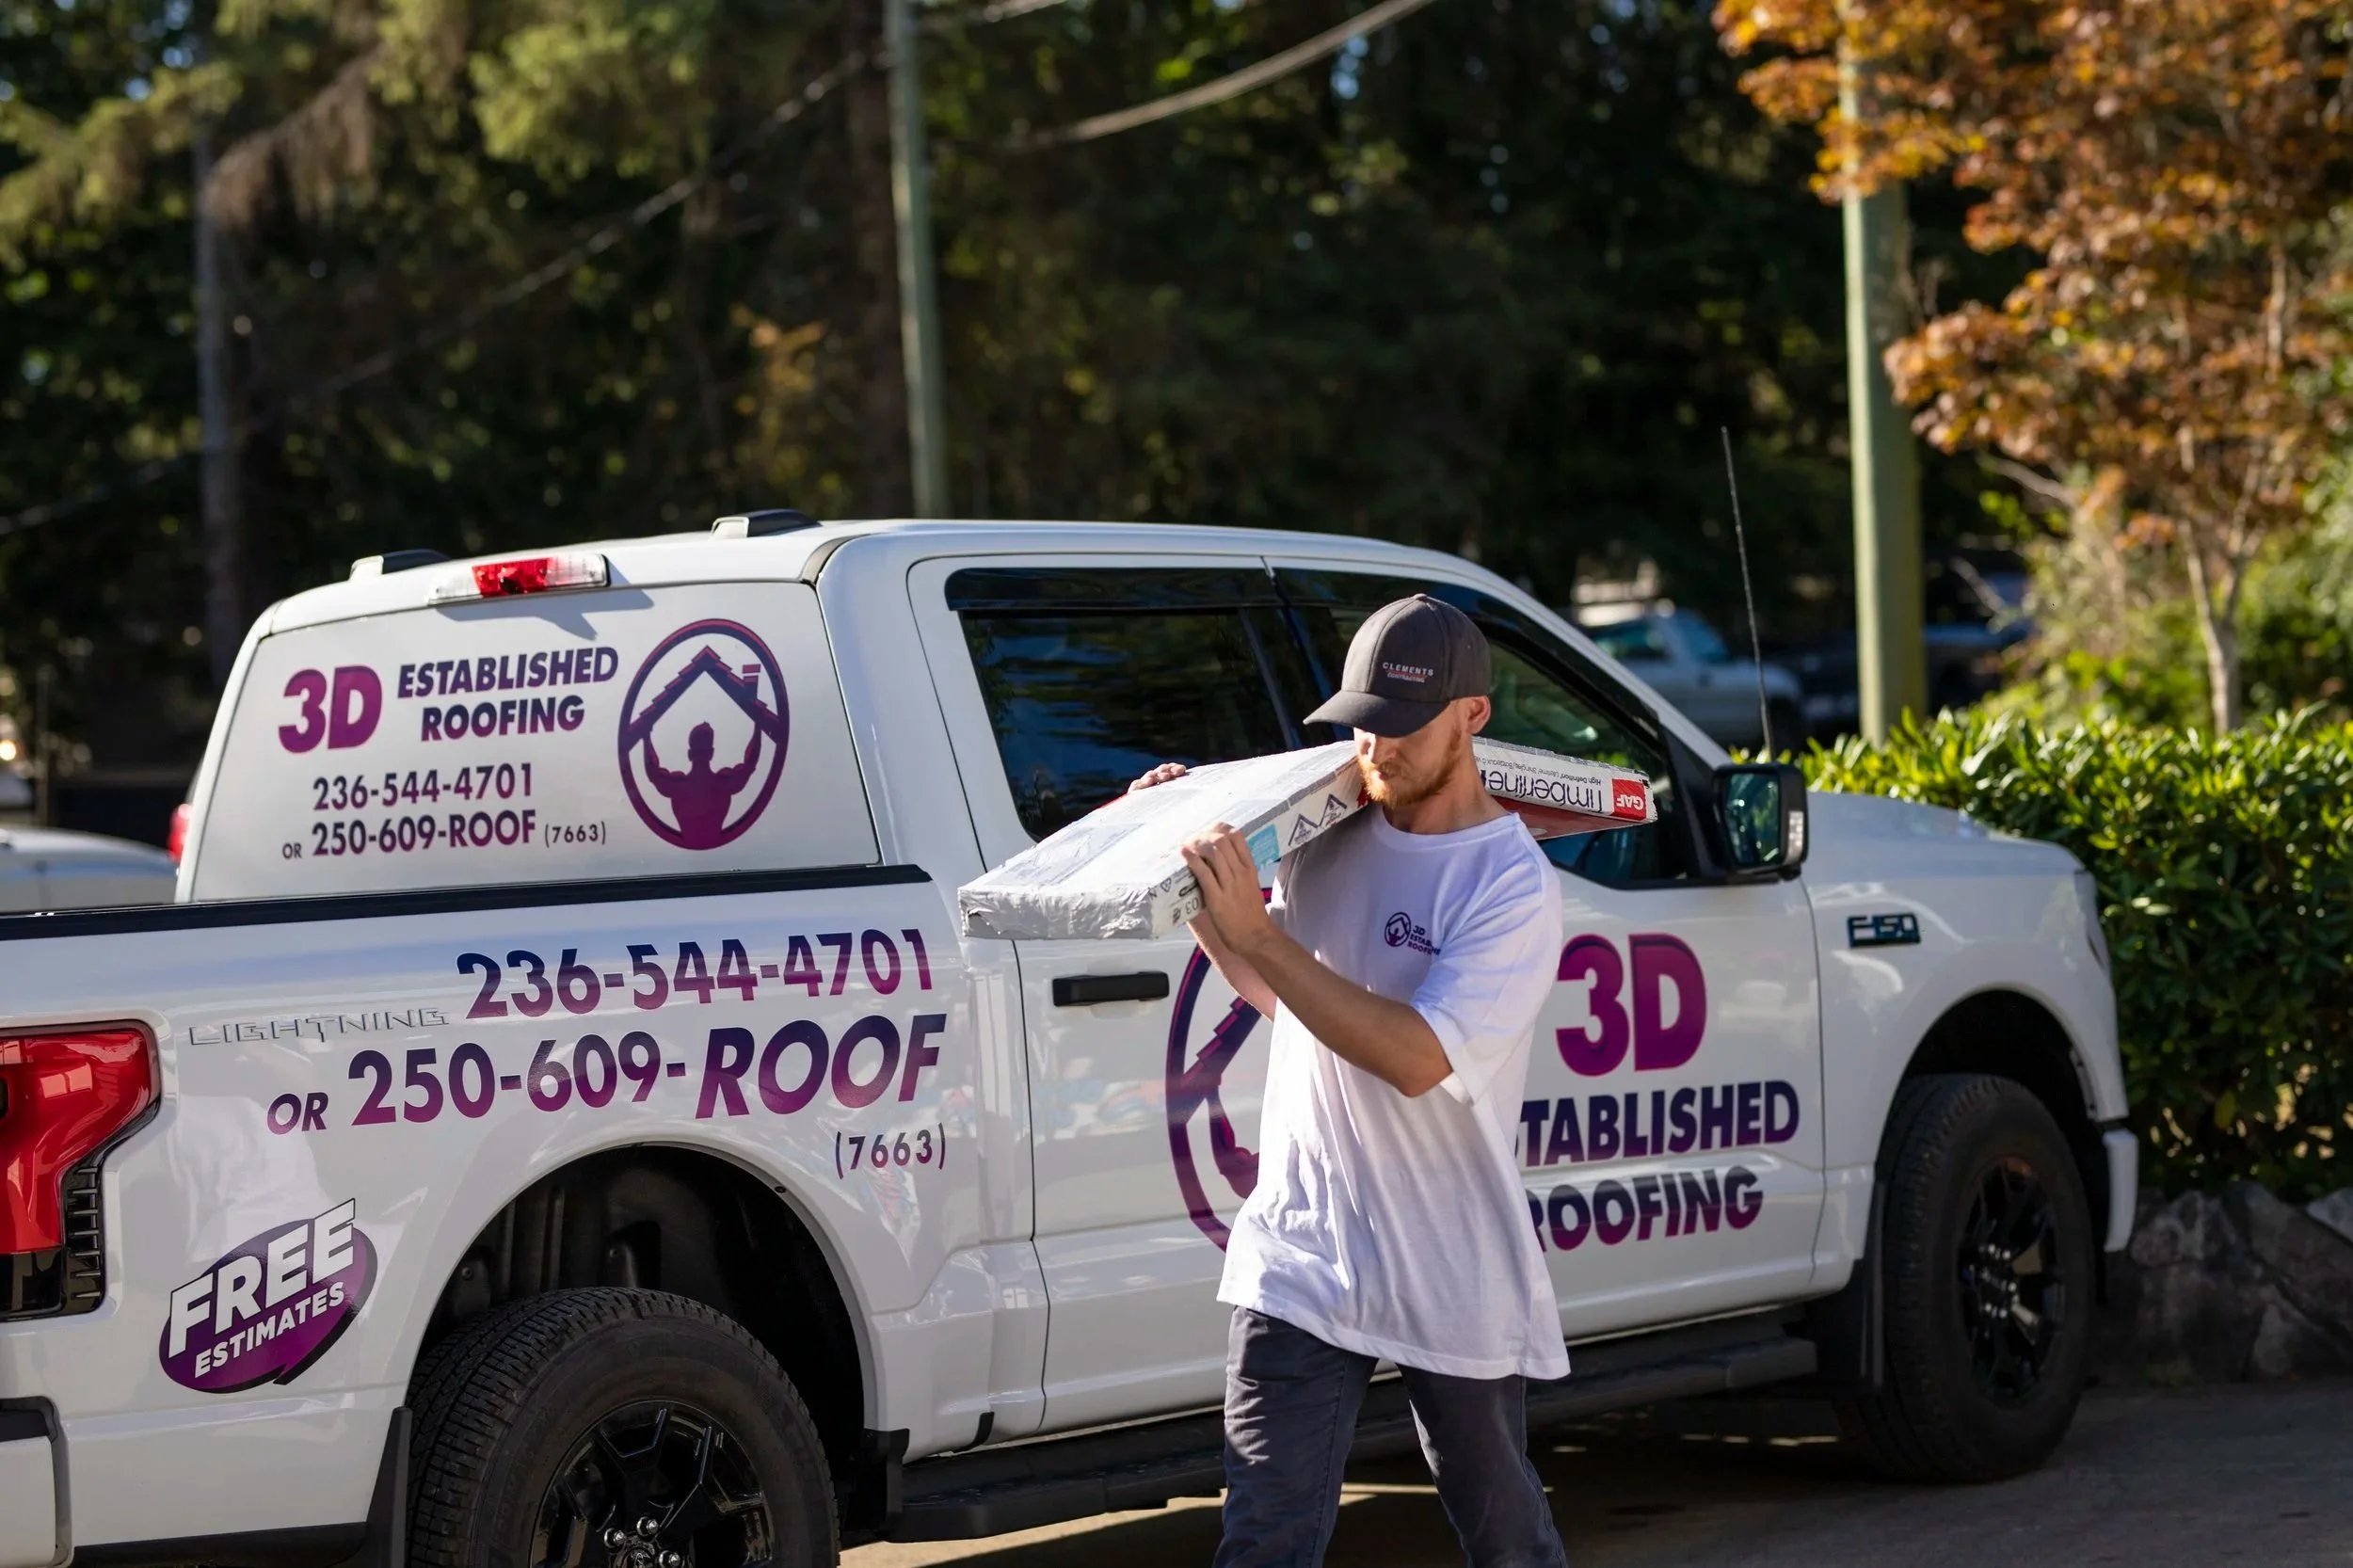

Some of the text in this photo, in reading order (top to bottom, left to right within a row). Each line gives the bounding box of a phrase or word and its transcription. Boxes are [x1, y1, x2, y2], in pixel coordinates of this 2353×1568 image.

[397, 646, 618, 698] ESTABLISHED
[1382, 662, 1434, 677] CLEMENTS
[278, 664, 383, 754] 3D
[421, 695, 585, 742] ROOFING
[312, 762, 533, 810] 236-544-4701
[1487, 770, 1604, 814] Timberline
[1615, 793, 1644, 810] GAF
[282, 809, 607, 859] OR 250-609-ROOF (7663)
[1413, 925, 1426, 936] 3D
[456, 928, 933, 1020] 236-544-4701
[189, 1007, 450, 1046] LIGHTNING
[1556, 933, 1707, 1077] 3D
[266, 1013, 947, 1135] OR 250-609-ROOF
[1514, 1079, 1800, 1167] TABLISHED
[835, 1122, 945, 1179] (7663)
[168, 1197, 355, 1359] FREE
[194, 1281, 344, 1379] ESTIMATES
